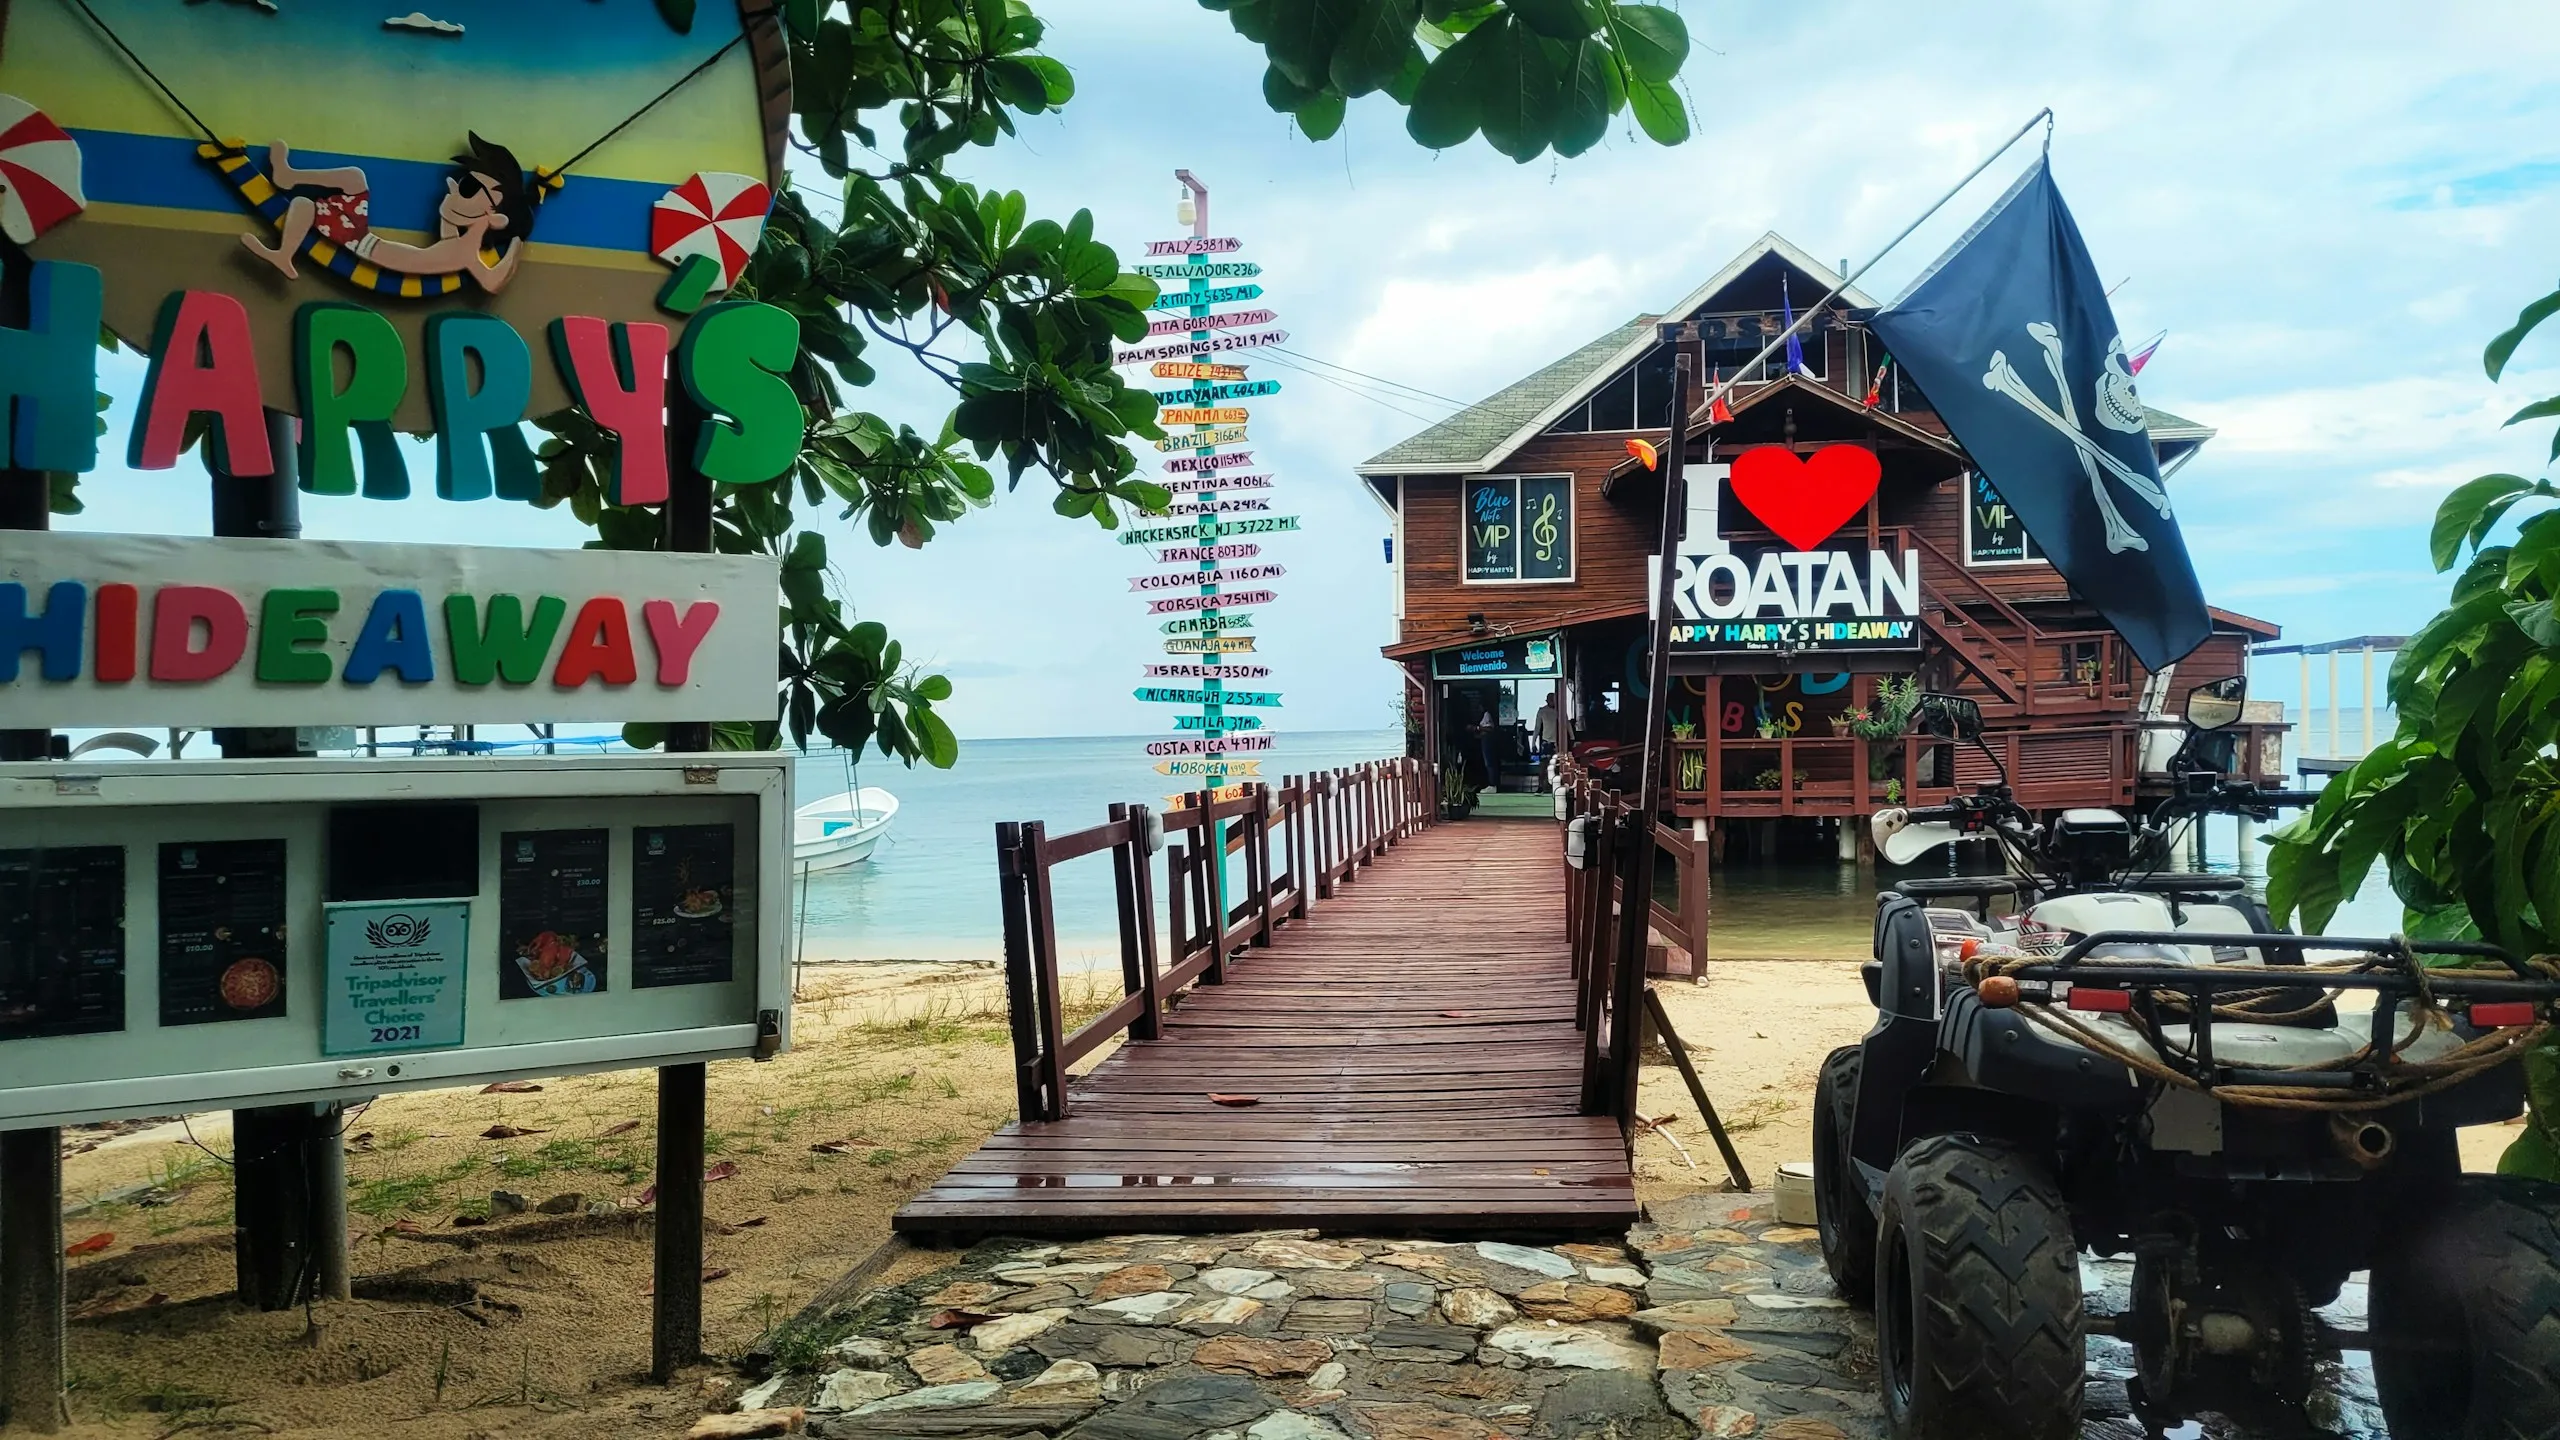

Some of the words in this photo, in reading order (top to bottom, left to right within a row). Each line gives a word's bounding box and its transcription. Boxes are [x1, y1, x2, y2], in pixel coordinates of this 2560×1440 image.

[1153, 239, 1193, 255] ITALY
[1196, 238, 1223, 251] 5981
[1155, 263, 1231, 278] SALVADOR
[1233, 263, 1253, 276] 236
[1204, 287, 1233, 303] 5635
[1236, 286, 1253, 300] MI
[1183, 315, 1227, 330] GORDA
[1118, 348, 1156, 363] PALM
[1157, 340, 1222, 359] SPRINGS
[1225, 335, 1257, 350] 2219
[1261, 333, 1281, 345] MI
[1158, 363, 1202, 377] BELIZE
[1234, 383, 1254, 397] 404
[1166, 409, 1220, 424] PANAMA
[1162, 433, 1210, 452] BRAZIL
[1171, 455, 1219, 472] MEXICO
[1472, 486, 1512, 514] Blue
[1480, 507, 1503, 523] Note
[1125, 523, 1209, 545] HACKENSACK
[1215, 522, 1231, 536] NJ
[1238, 518, 1274, 534] 3722
[1279, 517, 1295, 529] MI
[1472, 524, 1511, 549] VIP
[1992, 532, 2005, 546] by
[1163, 546, 1215, 562] FRANCE
[1486, 550, 1499, 565] by
[1140, 569, 1224, 589] COLOMBIA
[1230, 567, 1259, 581] 1160
[1262, 565, 1280, 577] MI
[1648, 548, 1920, 621] ROATAN
[1157, 595, 1222, 612] CORSICA
[1168, 616, 1227, 634] CANADA
[1669, 624, 1720, 643] APPY
[1815, 620, 1914, 640] HIDEAWAY
[0, 581, 720, 687] HIDEAWAY
[1165, 639, 1220, 652] GUANAJA
[1222, 640, 1236, 650] 44
[1461, 649, 1505, 661] Welcome
[1154, 665, 1210, 677] ISRAEL
[1214, 666, 1249, 678] 7350
[1251, 667, 1269, 678] MI
[1459, 659, 1508, 674] Bienvenido
[1146, 688, 1220, 703] NICARAGUA
[1225, 692, 1253, 705] 255
[1181, 716, 1225, 729] UTILA
[1146, 741, 1190, 756] COSTA
[1194, 740, 1227, 753] RICA
[1258, 736, 1271, 750] MI
[1170, 761, 1229, 776] HOBOKEN
[345, 972, 447, 993] Tripadvisor
[348, 988, 441, 1009] Travellers'
[364, 1008, 426, 1025] Choice
[370, 1025, 421, 1043] 2021
